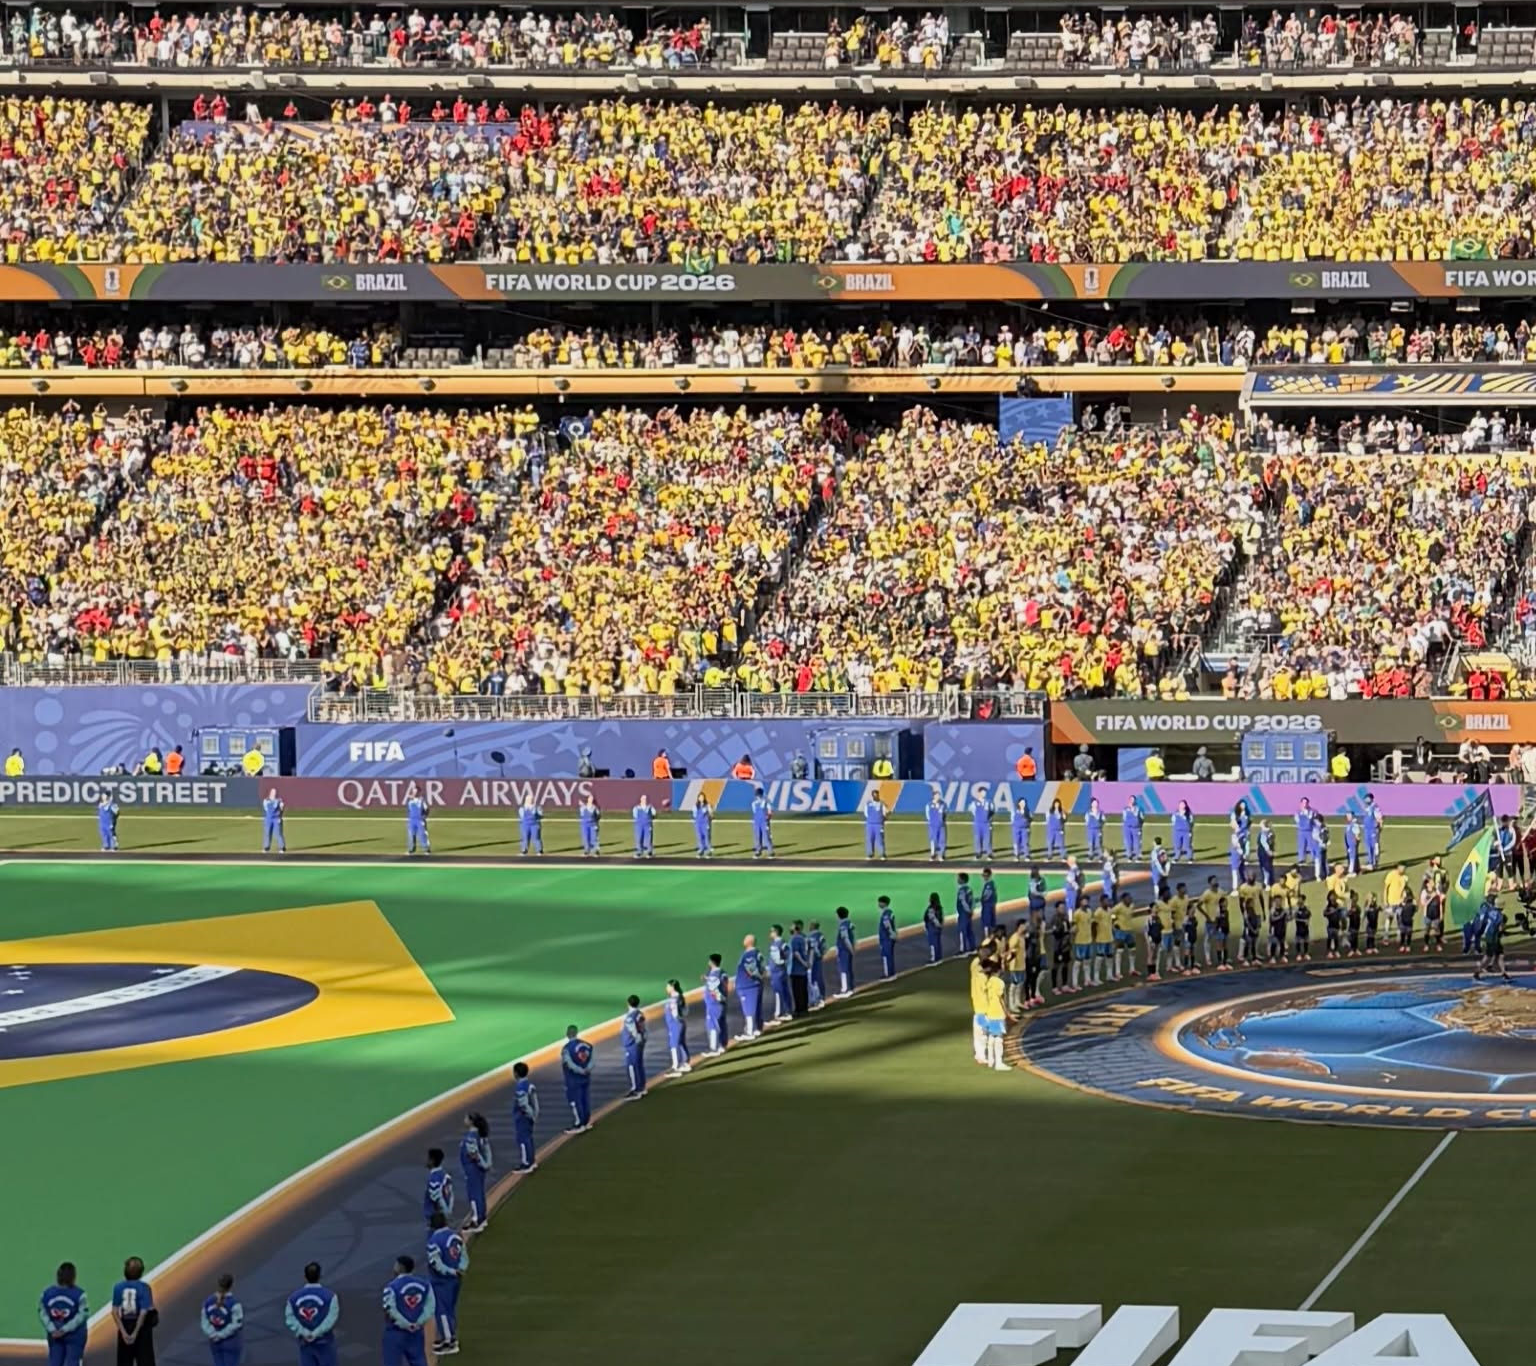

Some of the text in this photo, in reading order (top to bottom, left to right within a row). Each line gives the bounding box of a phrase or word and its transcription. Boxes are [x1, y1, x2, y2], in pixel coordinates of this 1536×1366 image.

[355, 272, 408, 292] BRAZIL
[485, 273, 736, 292] FIFA WORLD CUP 2026
[845, 272, 896, 293] BRAZIL
[1321, 270, 1371, 290] BRAZIL
[1445, 269, 1489, 289] FIFA
[1096, 715, 1322, 731] FIFA WORLD CUP 2026
[1465, 713, 1511, 731] BRAZIL
[349, 740, 404, 763] FIFA
[336, 780, 594, 807] QATAR AIRWAYS
[1136, 1077, 1244, 1102] FIFA
[1251, 1095, 1471, 1118] WORLD
